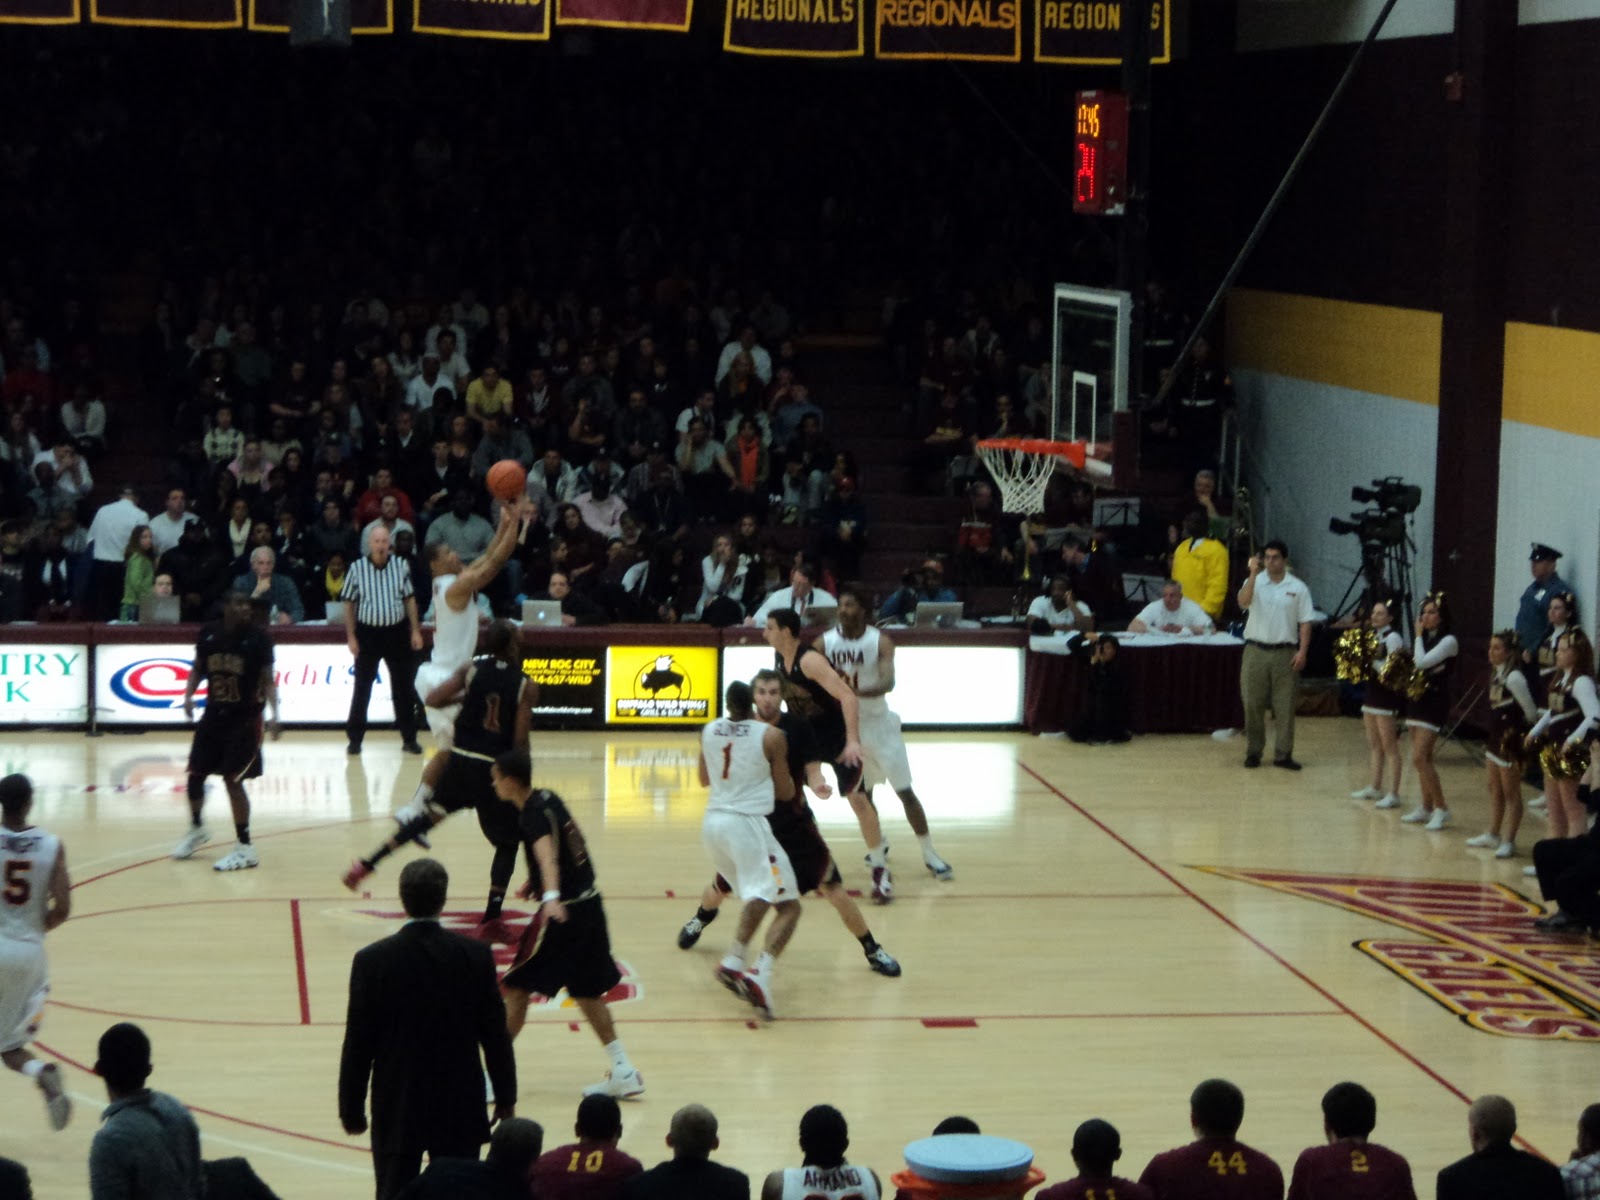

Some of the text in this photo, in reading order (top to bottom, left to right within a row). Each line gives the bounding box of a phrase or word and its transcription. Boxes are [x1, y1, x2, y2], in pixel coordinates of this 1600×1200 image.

[735, 0, 853, 23] REGIONALS
[881, 0, 1015, 29] REGIONALS
[1044, 1, 1160, 31] REGIONS
[523, 659, 596, 669] NEW ROC CITY
[617, 699, 706, 709] BUFFALO WILD WINGS
[722, 742, 733, 779] 1
[3, 861, 32, 904] 5
[566, 1150, 604, 1173] 10
[1207, 1150, 1248, 1175] 44
[1351, 1150, 1370, 1174] 2
